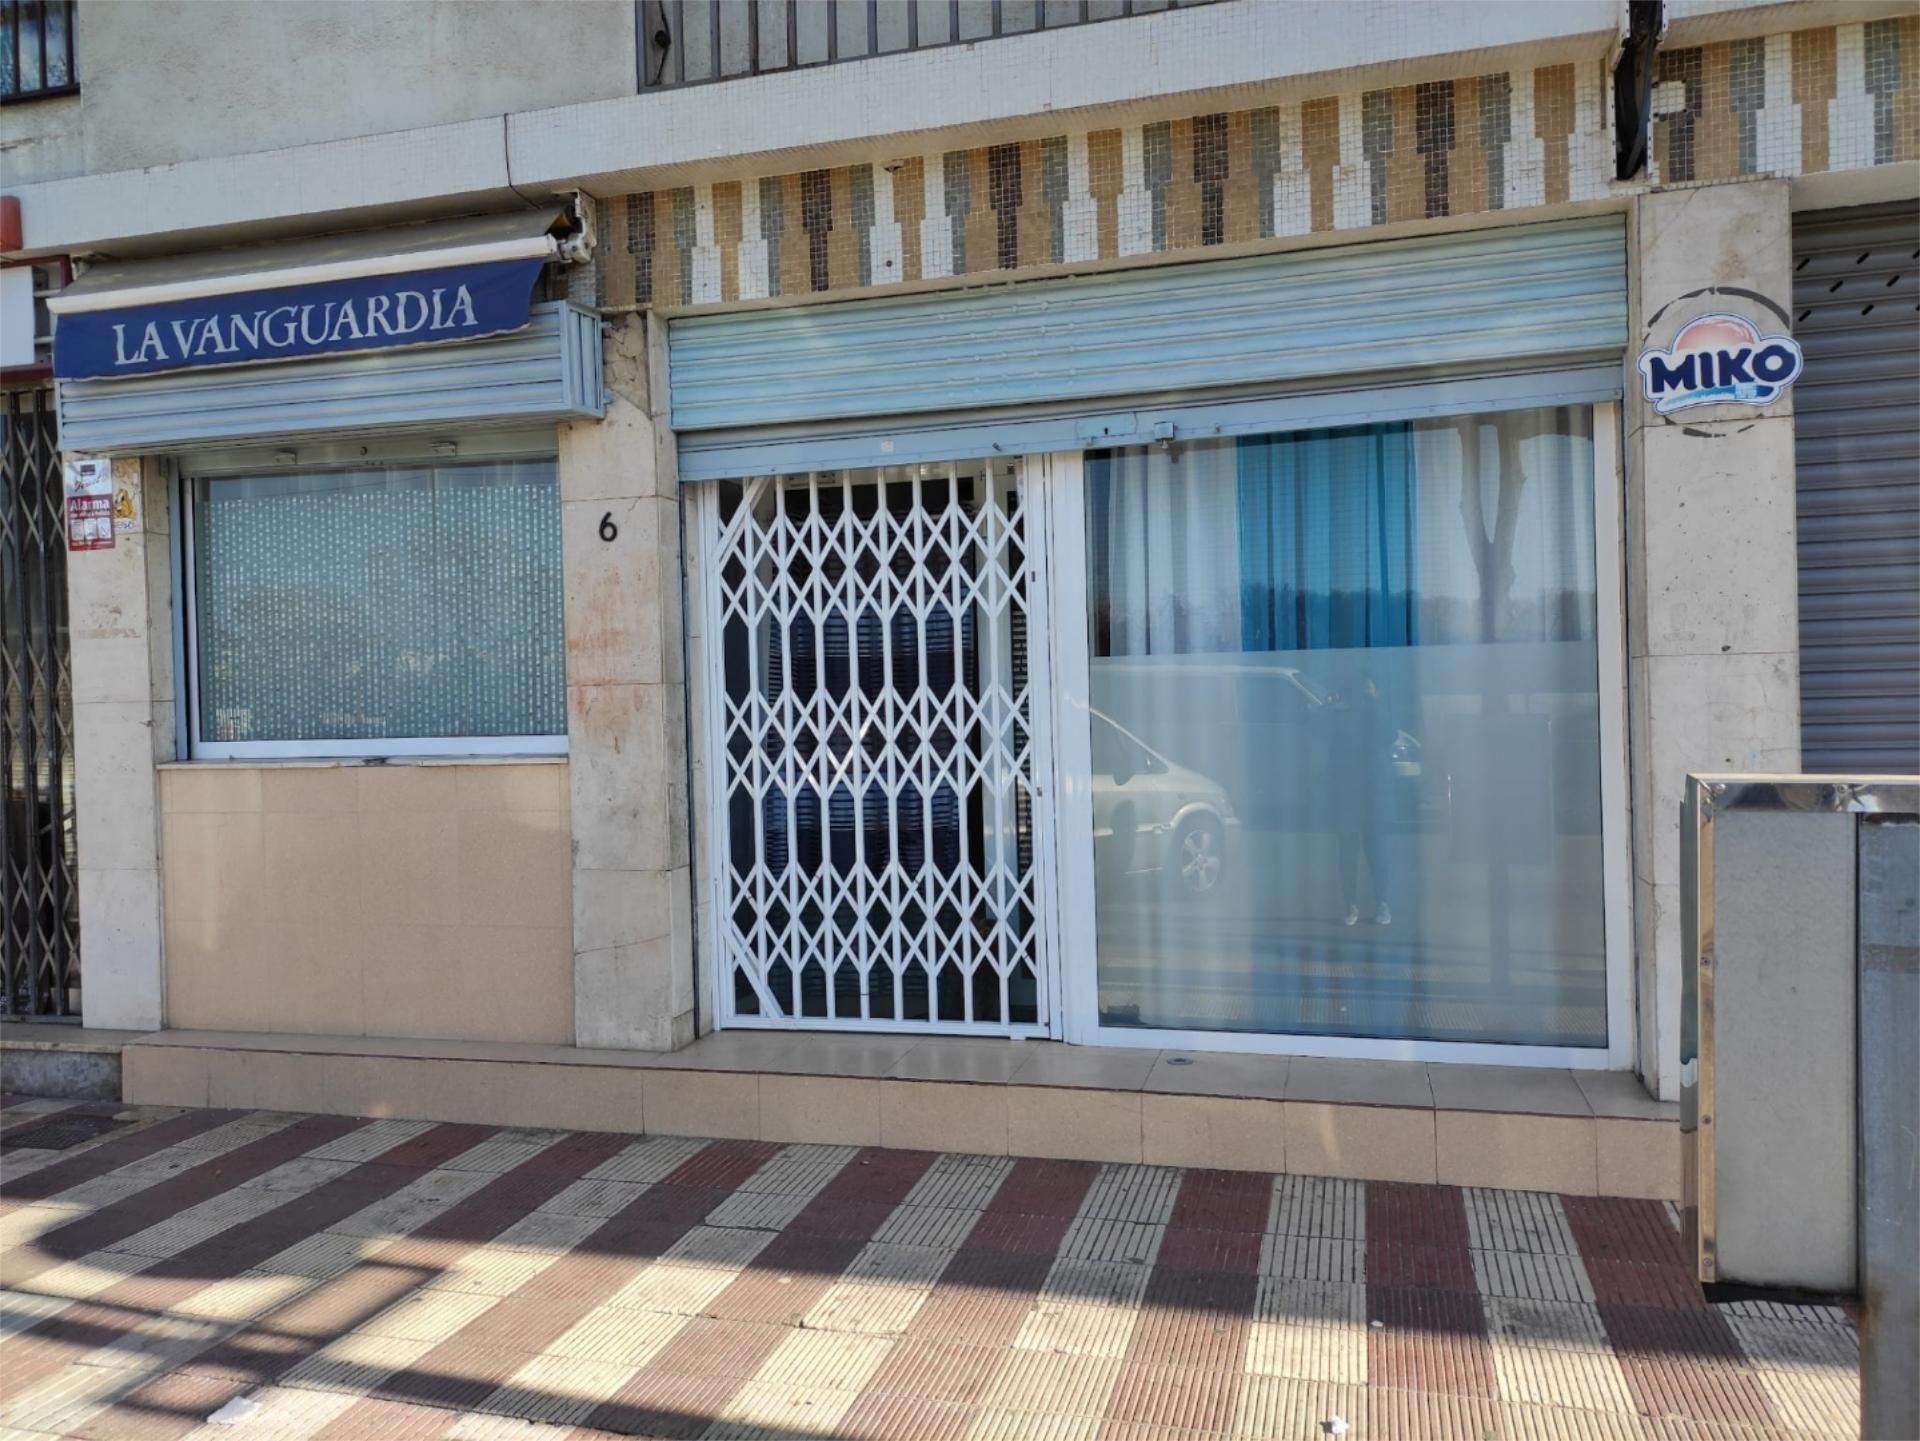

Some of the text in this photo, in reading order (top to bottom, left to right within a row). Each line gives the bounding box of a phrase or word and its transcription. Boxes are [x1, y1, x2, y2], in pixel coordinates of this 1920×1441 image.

[112, 284, 479, 366] LA VANGUARDIA
[1650, 345, 1796, 393] MIKO
[70, 499, 110, 511] Alarma
[599, 512, 617, 542] 6
